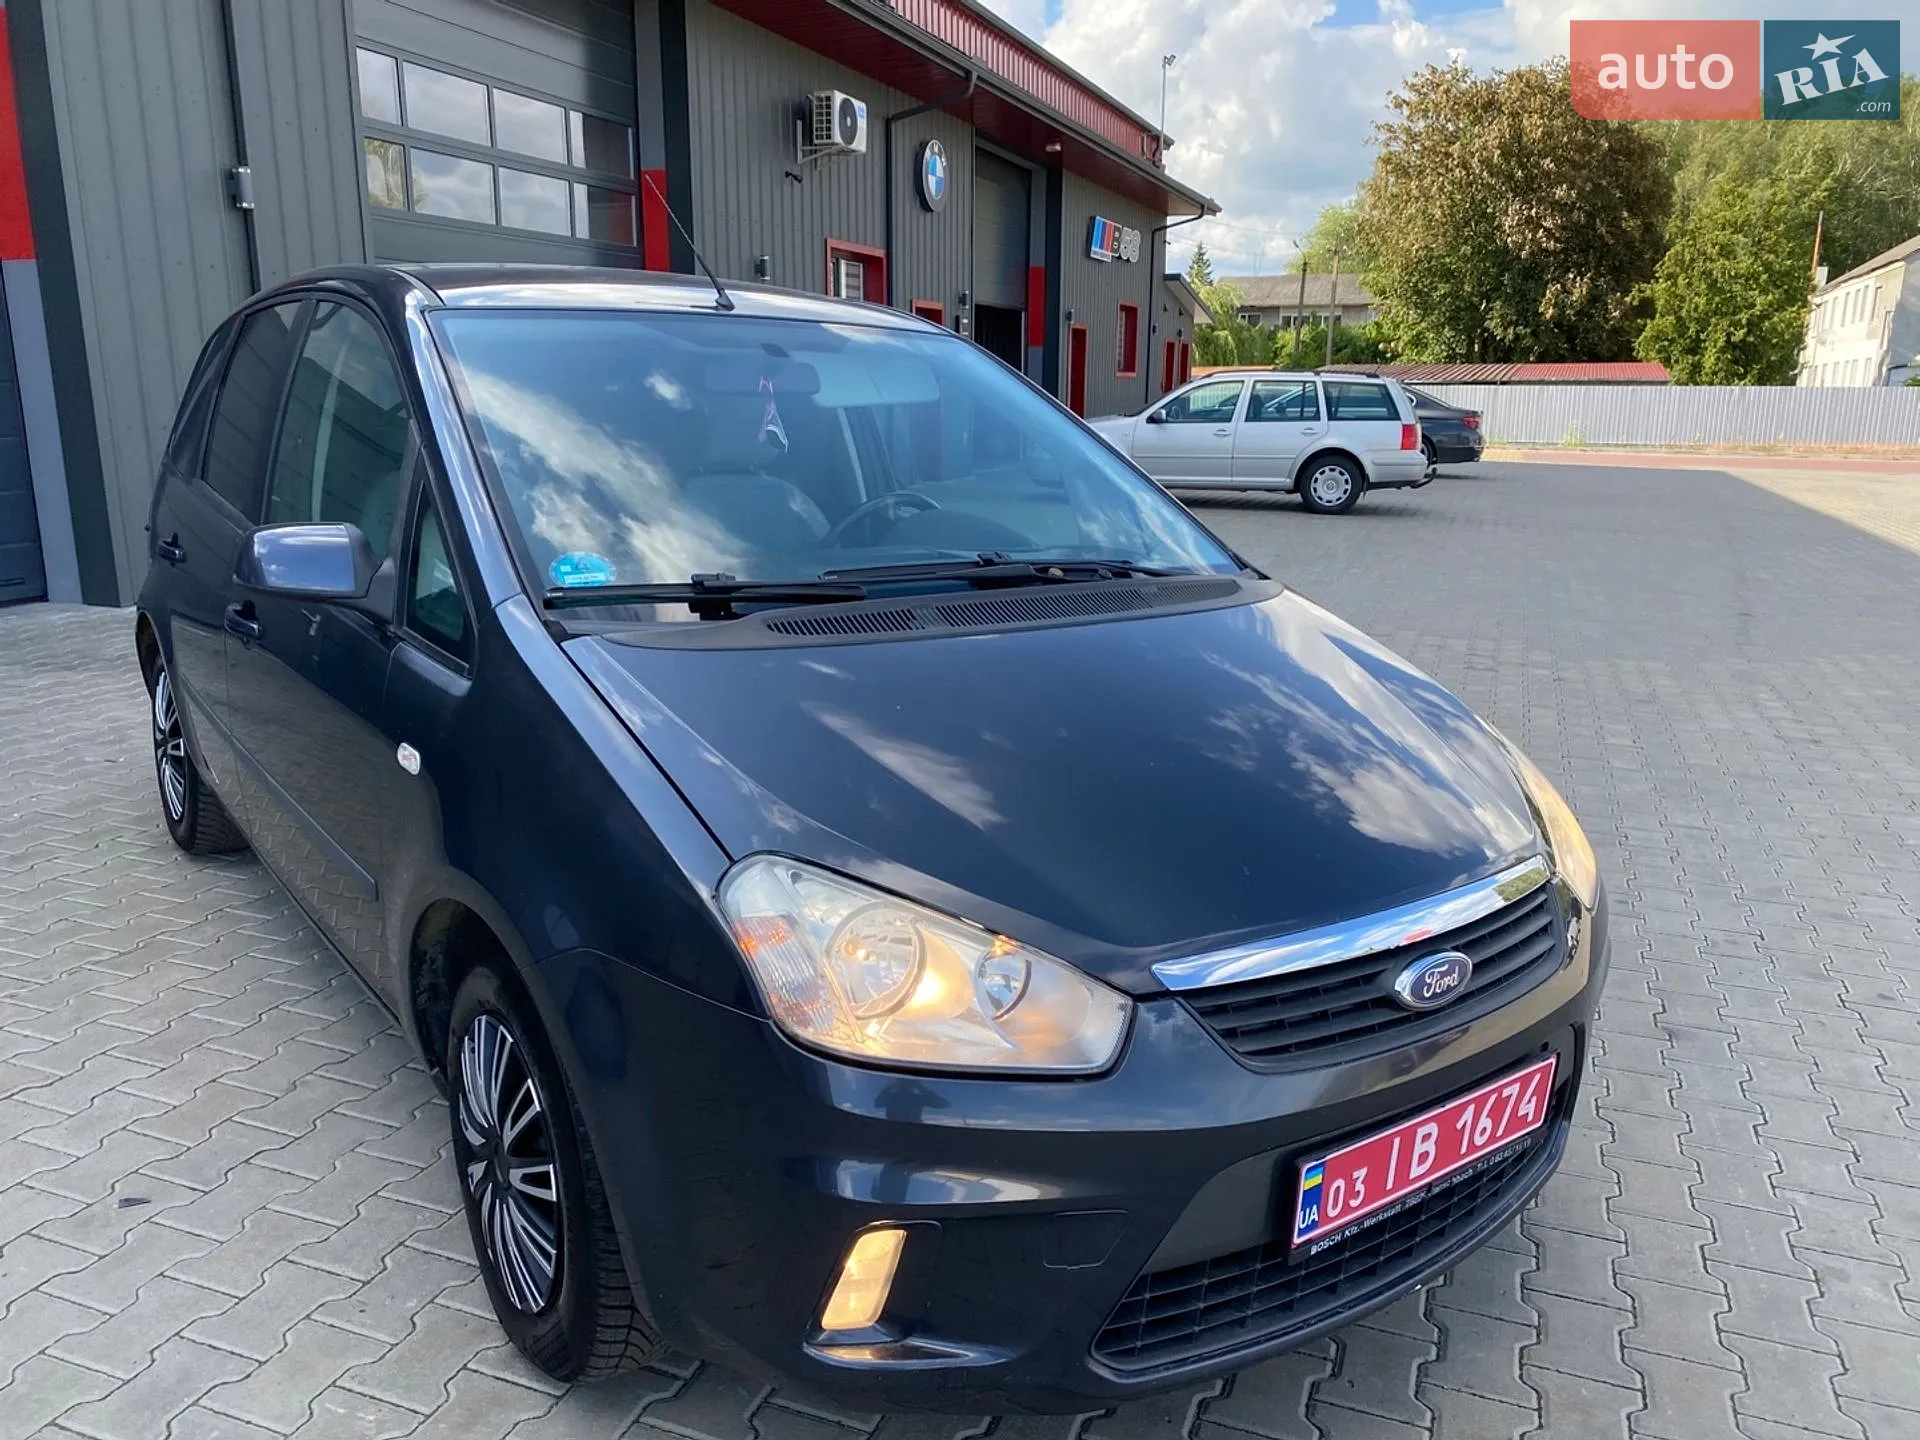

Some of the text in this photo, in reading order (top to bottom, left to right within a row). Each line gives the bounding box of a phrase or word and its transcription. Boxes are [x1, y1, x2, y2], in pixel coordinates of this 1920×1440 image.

[1423, 964, 1460, 998] Ford
[1326, 1166, 1368, 1218] 03
[1385, 1121, 1439, 1191] IB
[1455, 1072, 1542, 1156] 1674
[1298, 1204, 1319, 1229] UA
[1310, 1231, 1343, 1256] BOSCH
